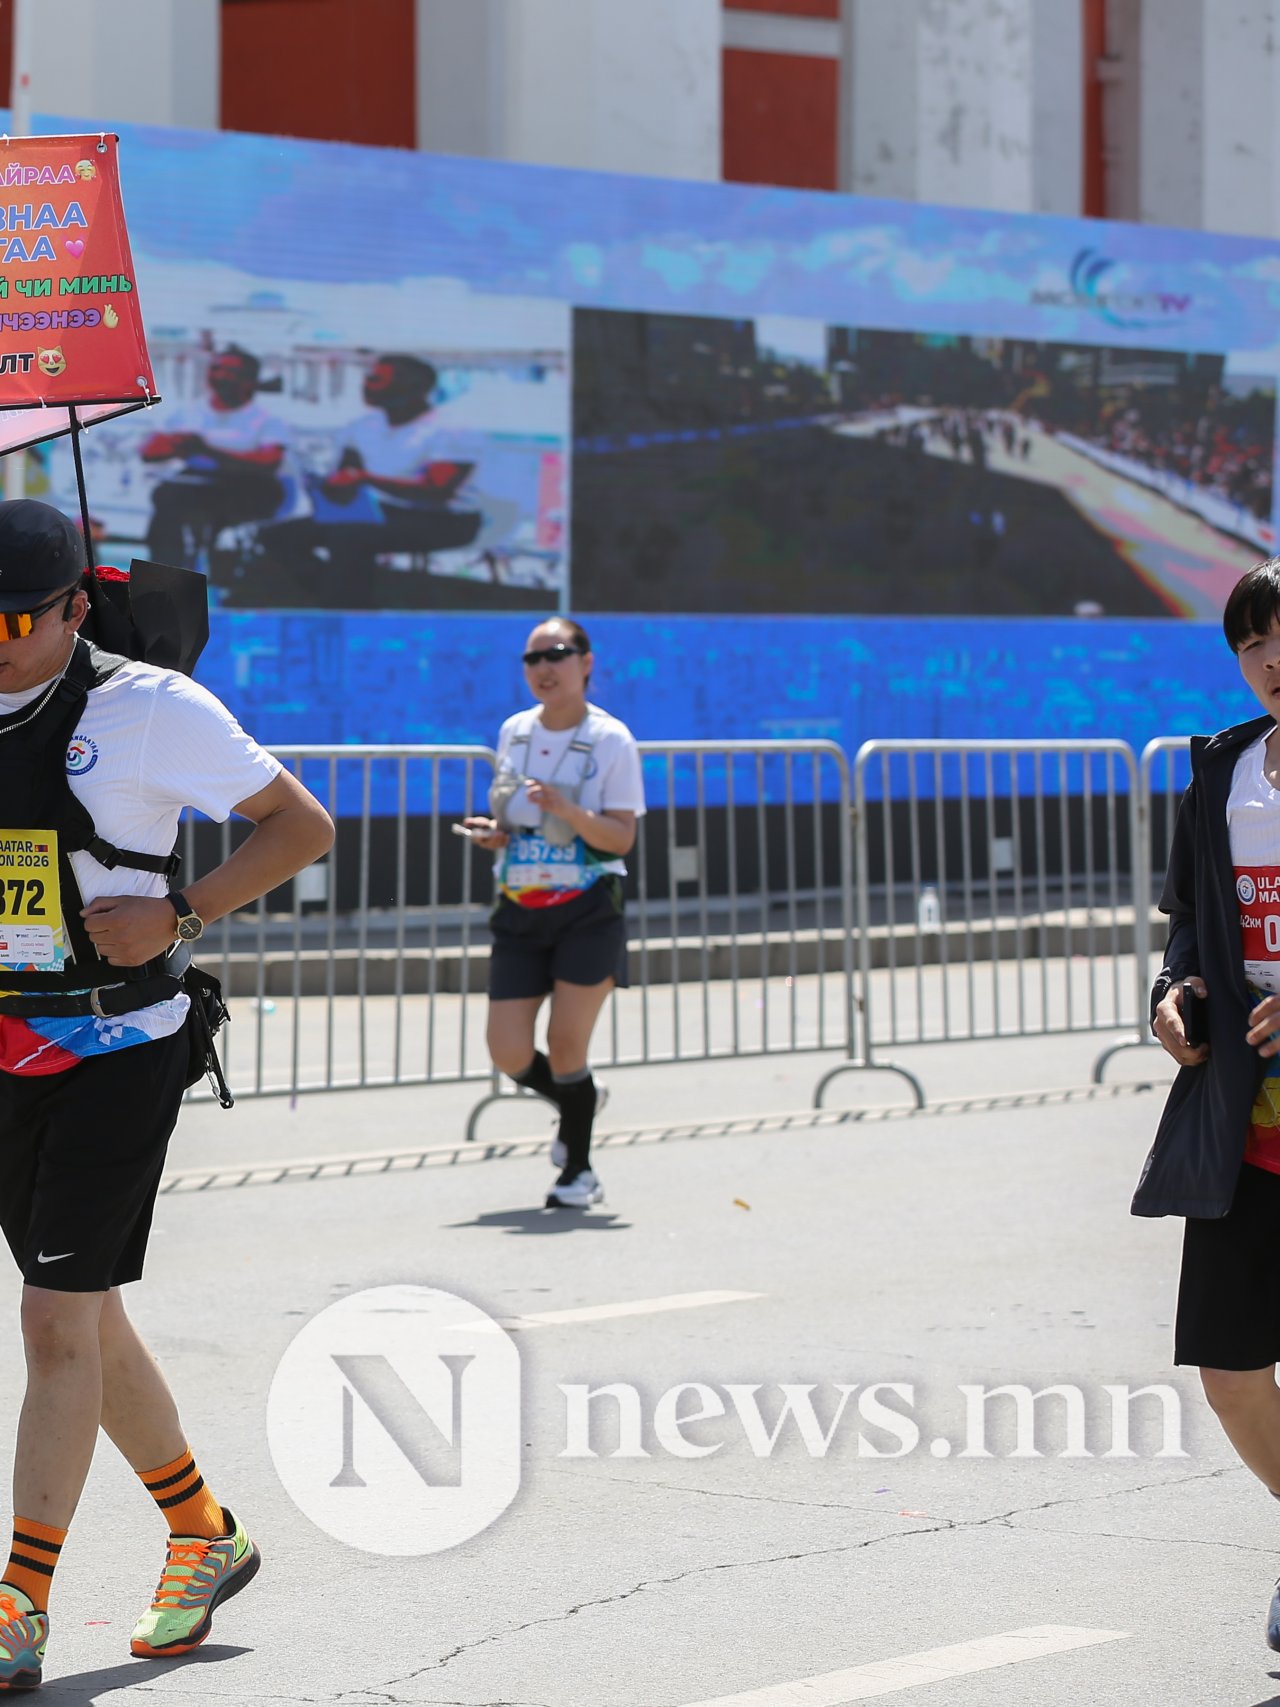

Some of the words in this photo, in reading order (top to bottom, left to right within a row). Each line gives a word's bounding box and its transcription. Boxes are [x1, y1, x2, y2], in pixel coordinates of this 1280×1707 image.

[15, 277, 53, 298] ЧИ
[59, 274, 132, 296] МИНЬ
[17, 855, 49, 867] 2026
[1257, 876, 1280, 889] ULA
[1259, 890, 1280, 903] MA
[1264, 914, 1280, 953] 0
